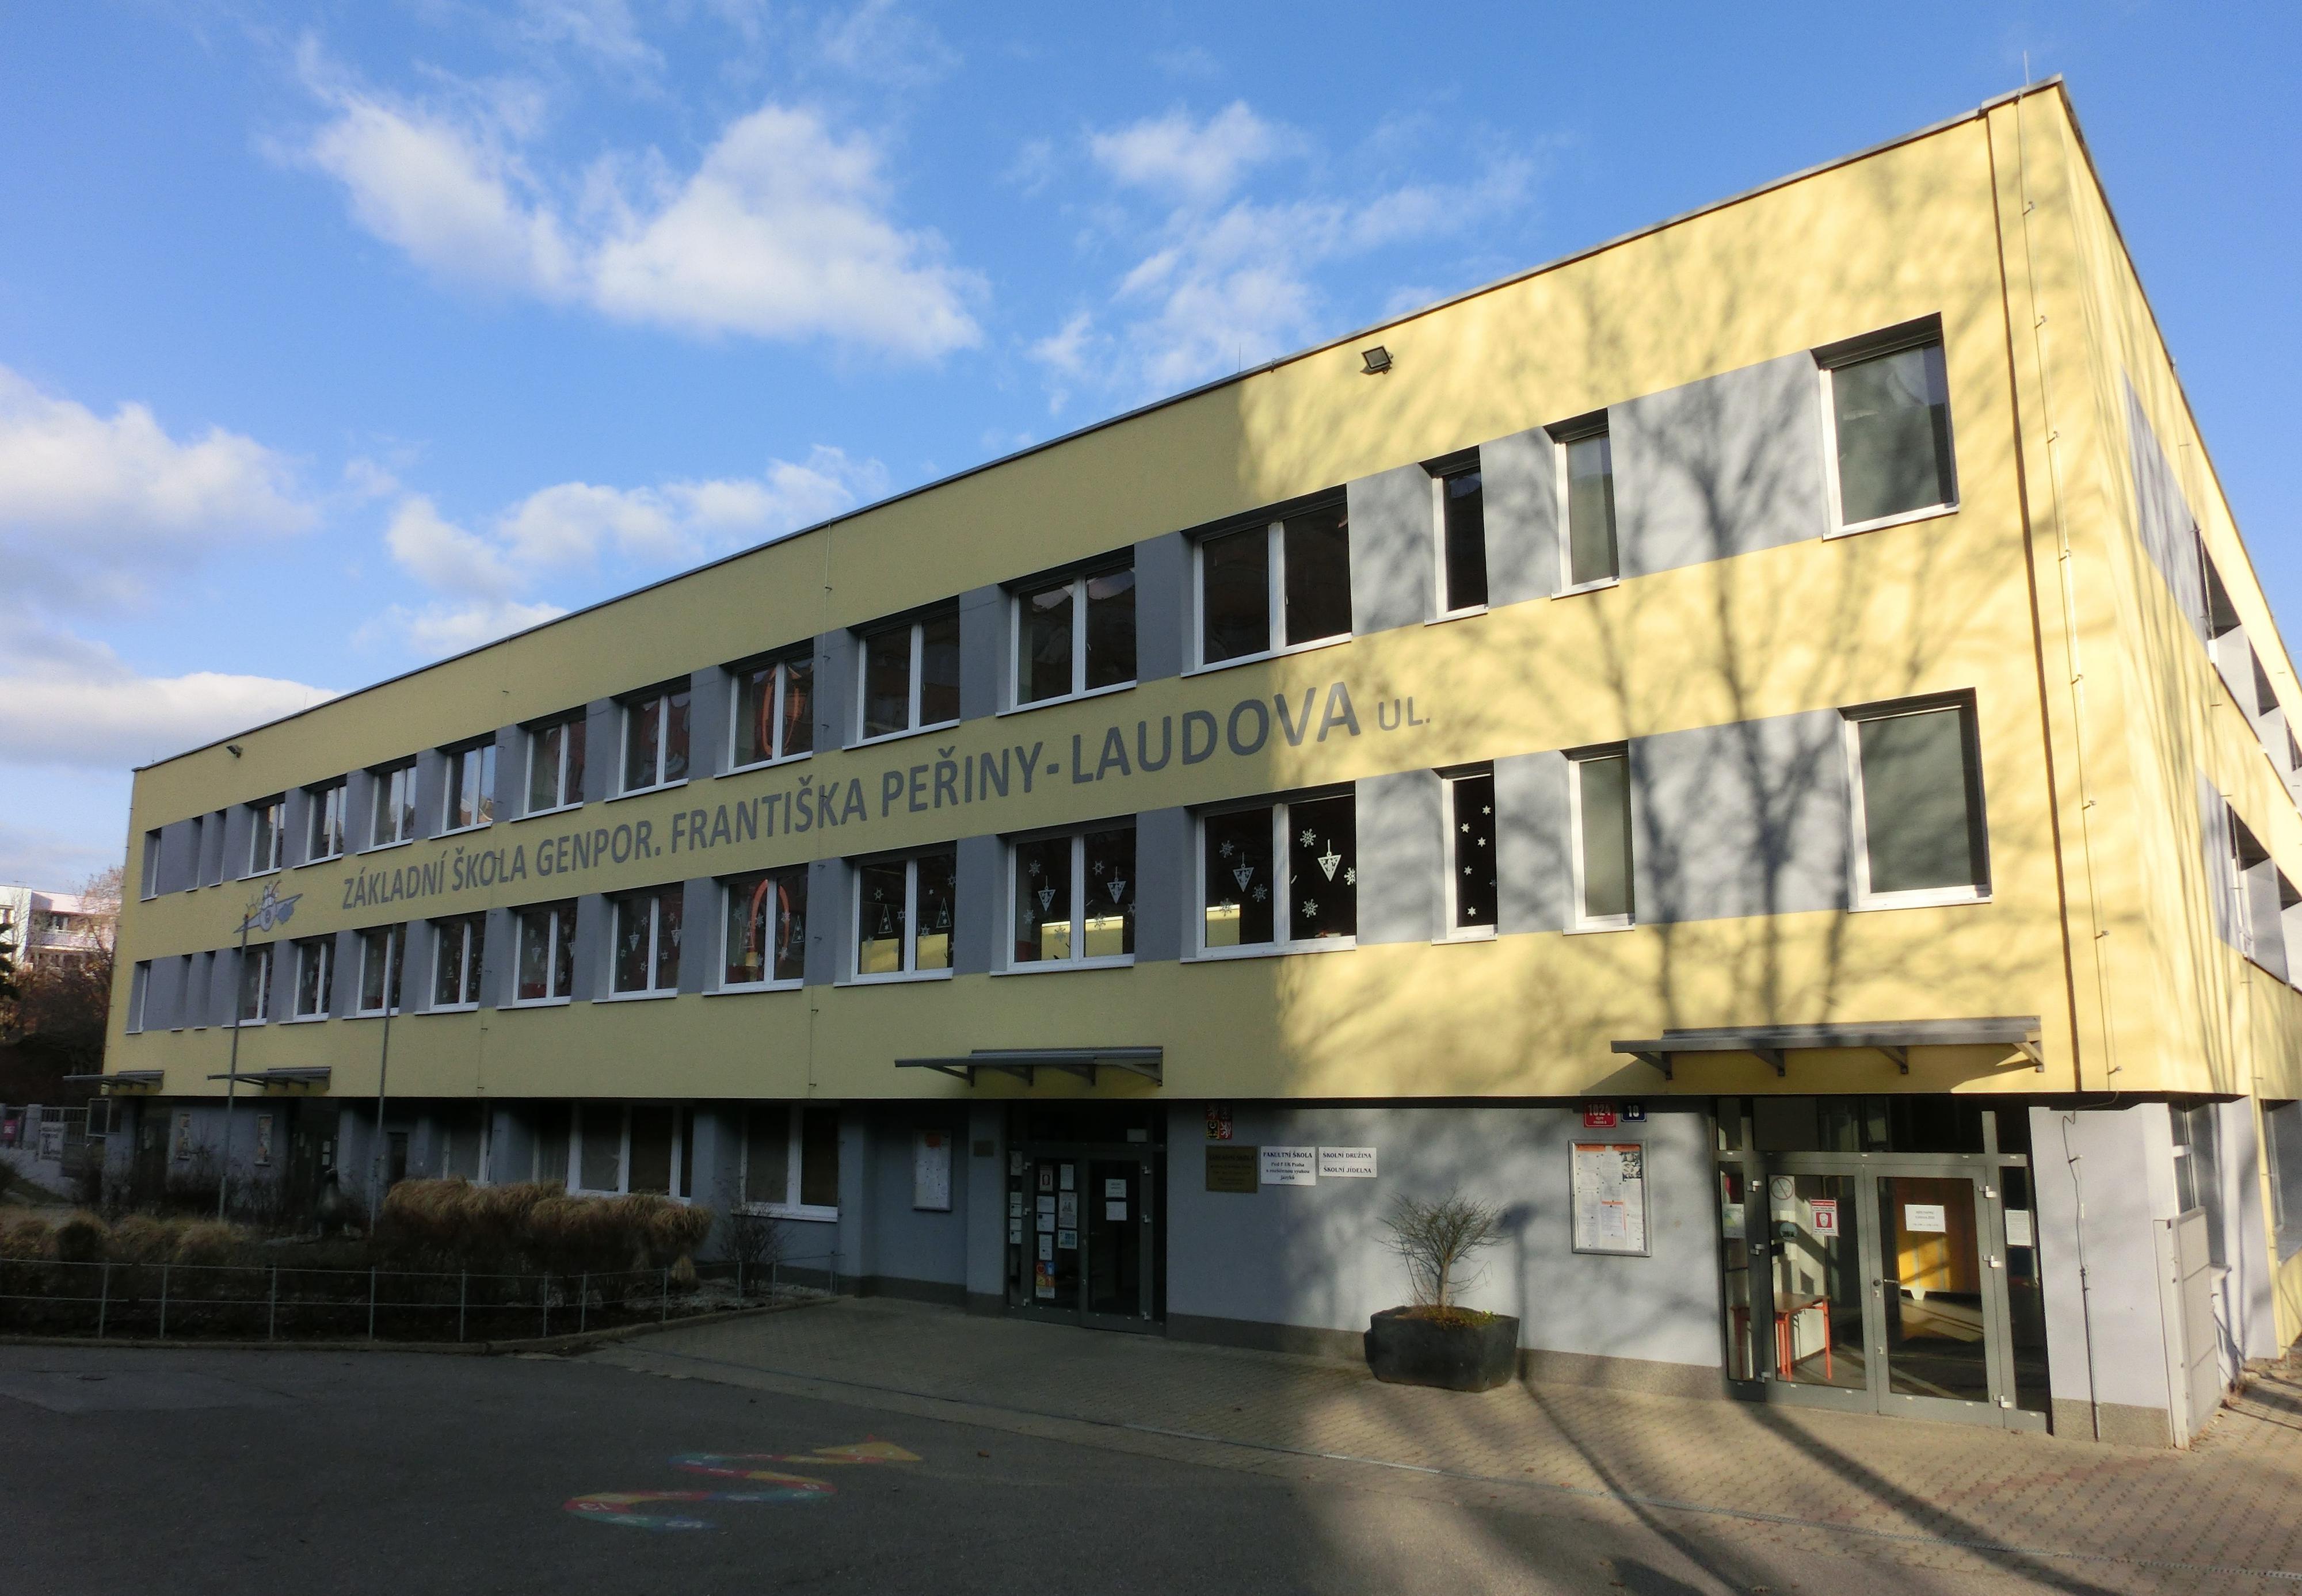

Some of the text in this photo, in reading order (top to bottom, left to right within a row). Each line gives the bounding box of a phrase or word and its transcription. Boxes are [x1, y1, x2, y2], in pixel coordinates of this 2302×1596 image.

[342, 850, 448, 909] ZÁKLADNÍ
[452, 846, 527, 891] ŠKOLA
[536, 820, 661, 876] GENPOR.
[671, 774, 867, 853] FRANTIŠKA
[1378, 697, 1430, 732] UL.
